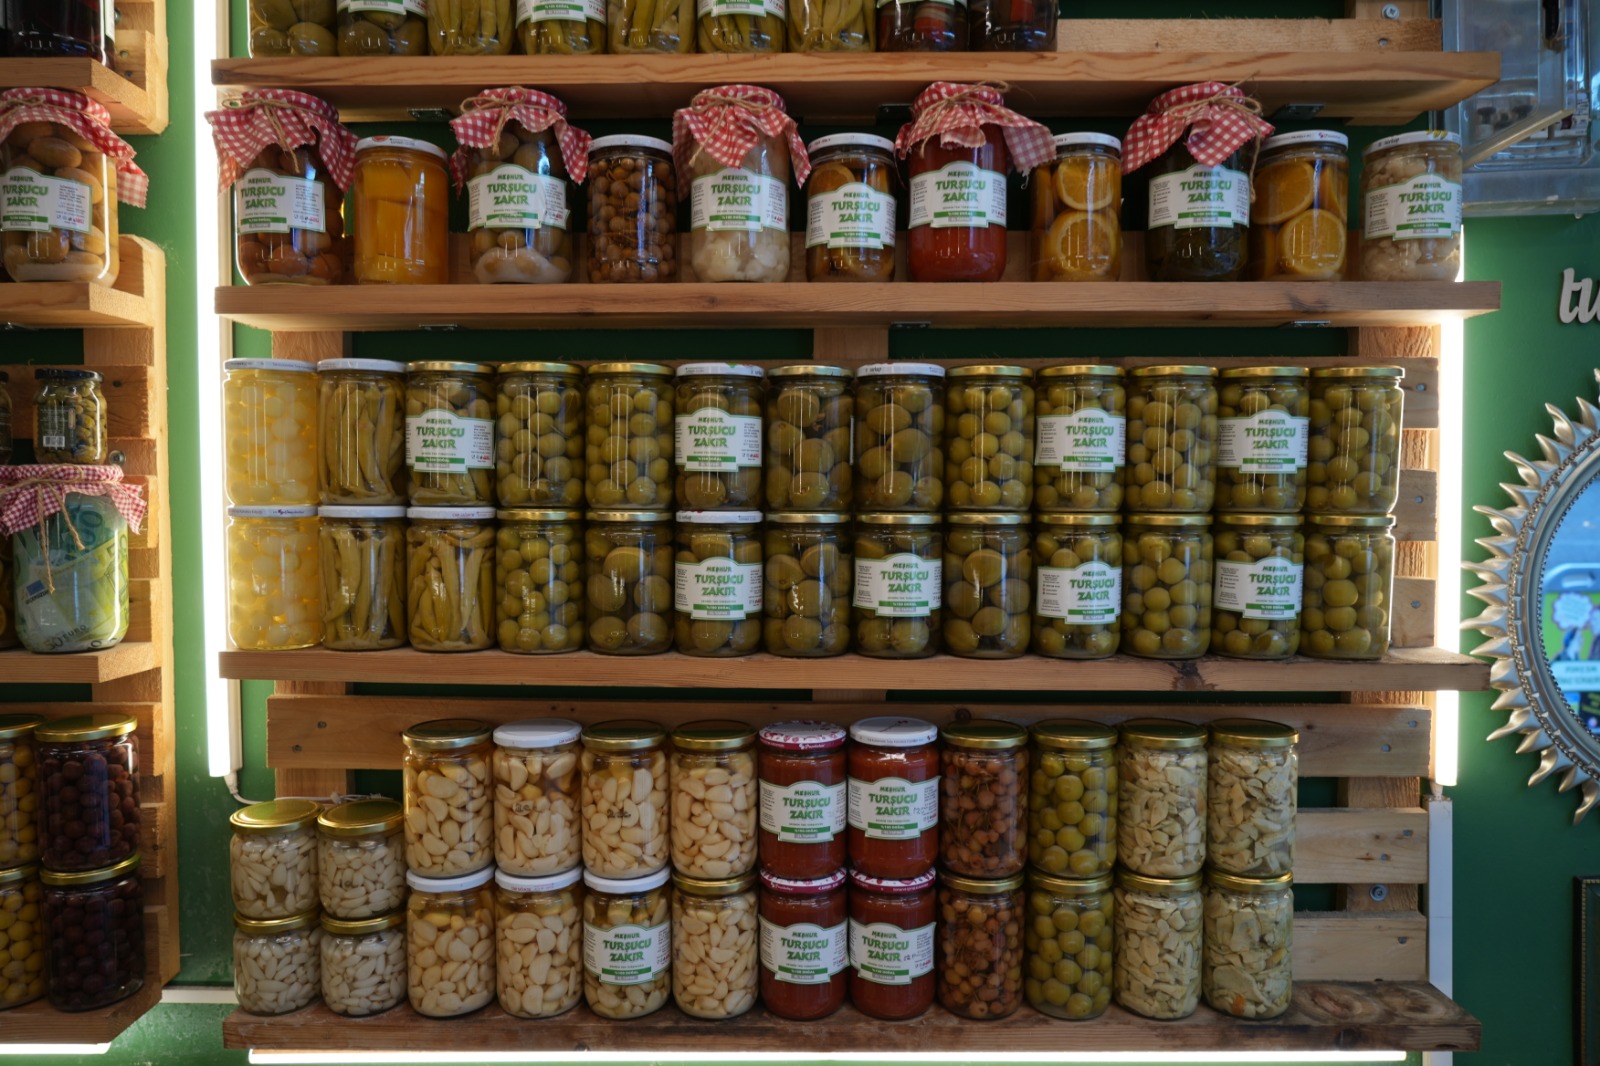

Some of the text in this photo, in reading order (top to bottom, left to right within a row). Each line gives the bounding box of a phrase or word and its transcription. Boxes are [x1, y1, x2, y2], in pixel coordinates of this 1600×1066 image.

[2, 185, 49, 196] TURŞUCU
[487, 183, 537, 194] TURŞUCU
[711, 183, 761, 195] TURŞUCU
[935, 180, 985, 191] TURŞUCU
[1180, 181, 1231, 191] TURŞUCU
[241, 186, 286, 197] TURŞUCU
[1398, 192, 1451, 203] TURŞUCU
[832, 201, 880, 212] TURŞUCU
[416, 426, 465, 437] TURŞUCU
[688, 425, 736, 436] TURŞUCU
[1065, 426, 1114, 436] TURŞUCU
[1245, 427, 1296, 438] TURŞUCU
[695, 574, 744, 585] TURŞUCU
[881, 571, 929, 582] TURŞUCU
[1249, 573, 1296, 584] TURŞUCU
[1070, 578, 1115, 590] TURŞUCU
[783, 797, 831, 809] TURŞUCU
[868, 793, 918, 805] TURŞUCU
[603, 939, 652, 952] TURŞUCU
[780, 937, 829, 951] TURŞUCU
[862, 935, 909, 951] TURŞUCU
